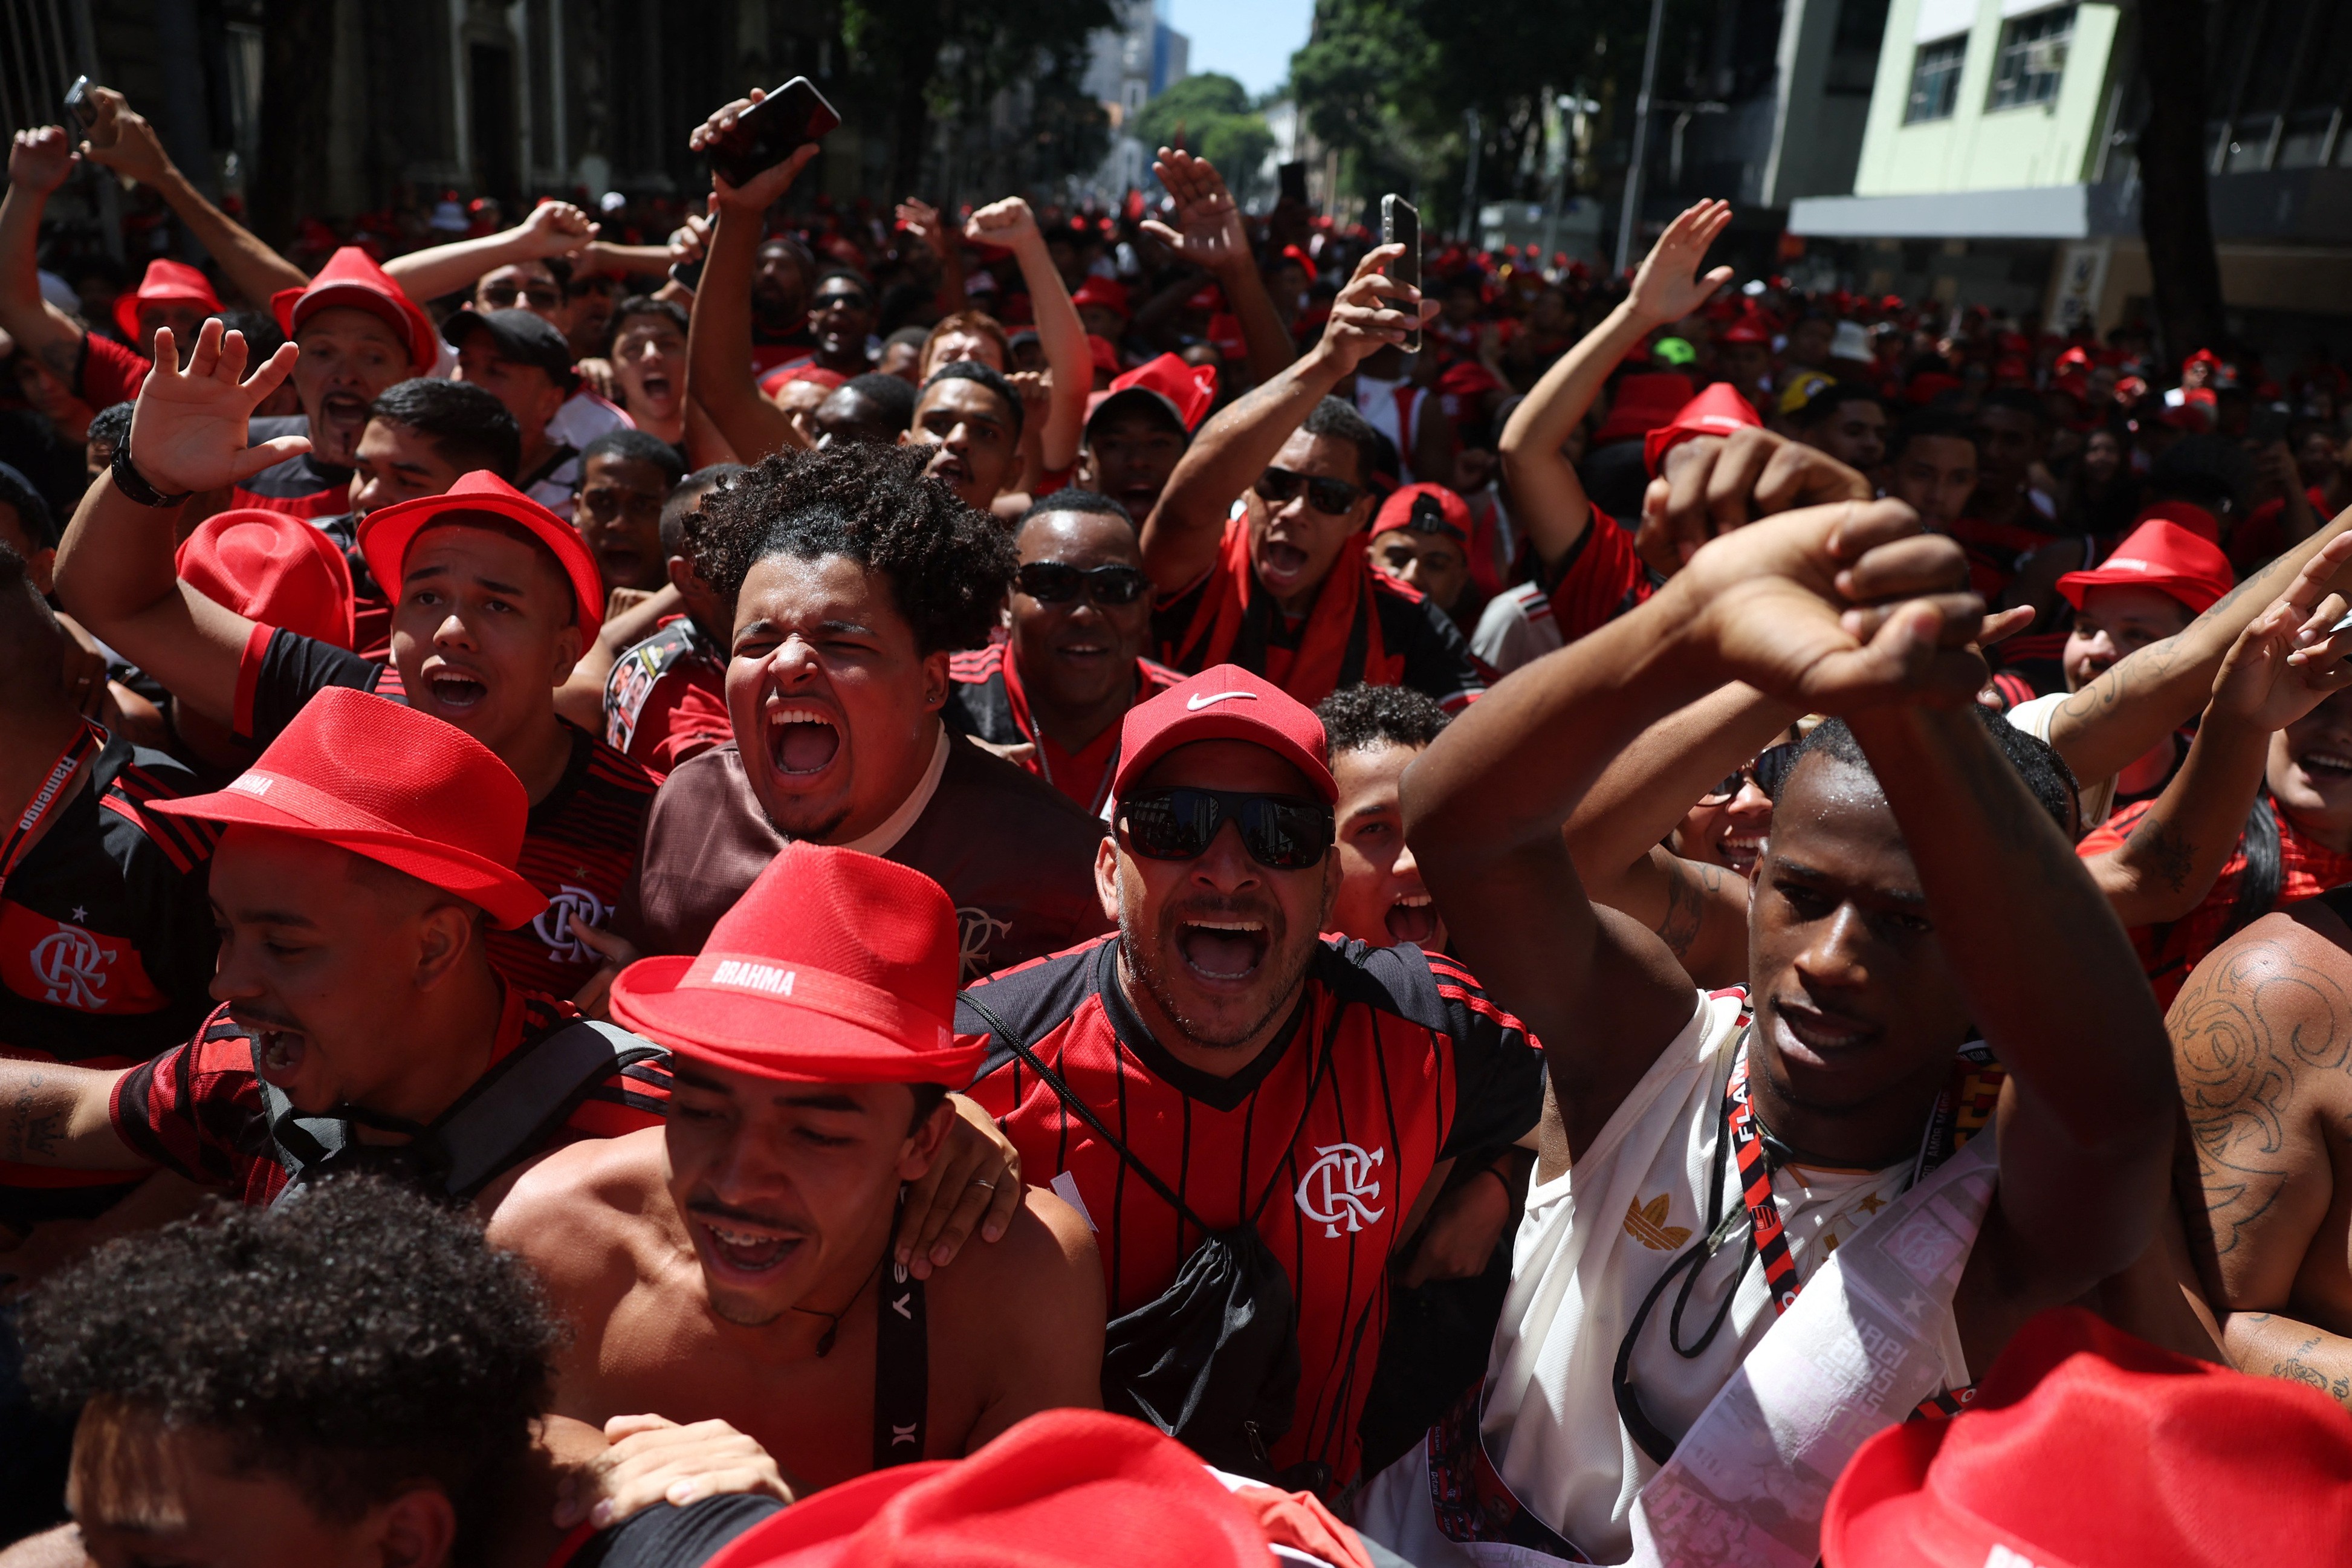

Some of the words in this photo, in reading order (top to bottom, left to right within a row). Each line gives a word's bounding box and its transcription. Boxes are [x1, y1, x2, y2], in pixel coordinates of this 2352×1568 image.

[19, 756, 79, 831] Flamengo
[711, 959, 797, 997] BRAHMA
[1927, 1127, 1943, 1157] AMOR
[1431, 1471, 1440, 1495] Betano
